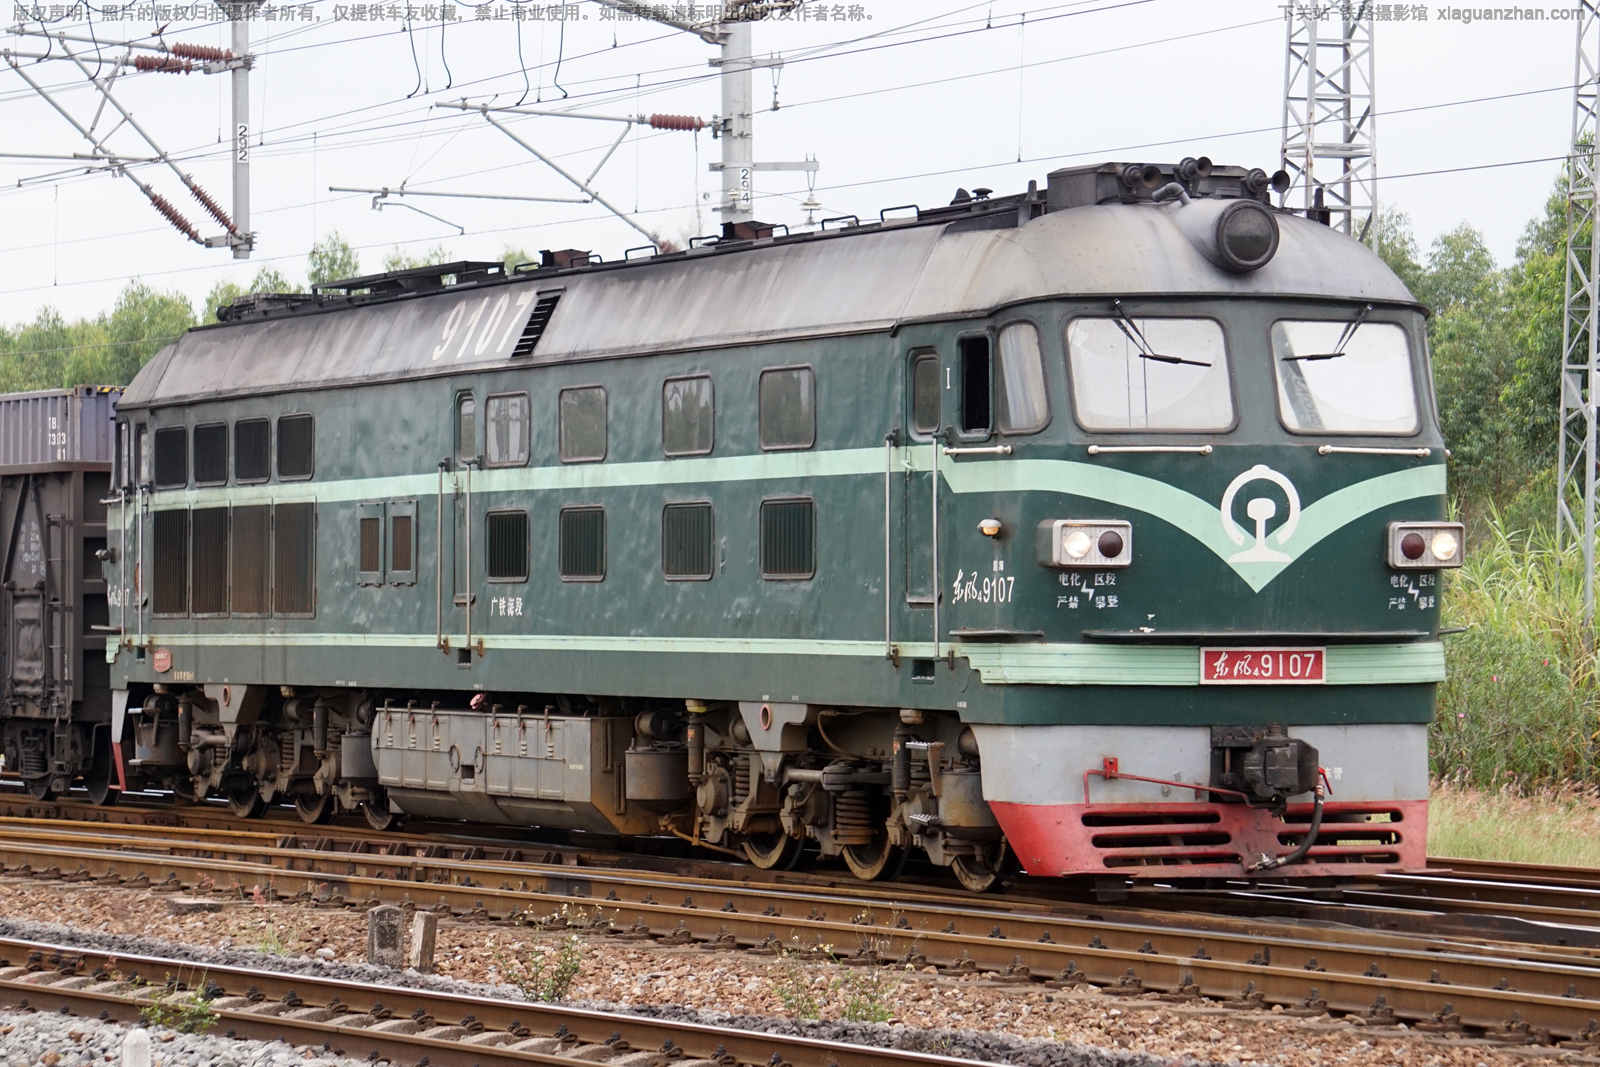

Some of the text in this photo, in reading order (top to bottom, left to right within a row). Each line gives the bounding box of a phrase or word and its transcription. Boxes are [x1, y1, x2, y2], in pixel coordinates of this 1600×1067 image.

[238, 125, 248, 161] 292
[741, 168, 750, 203] 294
[432, 290, 537, 361] 9107
[1059, 573, 1116, 586] 电化 区段
[1390, 574, 1435, 588] 电化 区段
[1057, 595, 1119, 609] 严禁 攀登
[1388, 596, 1435, 610] 严禁 攀登
